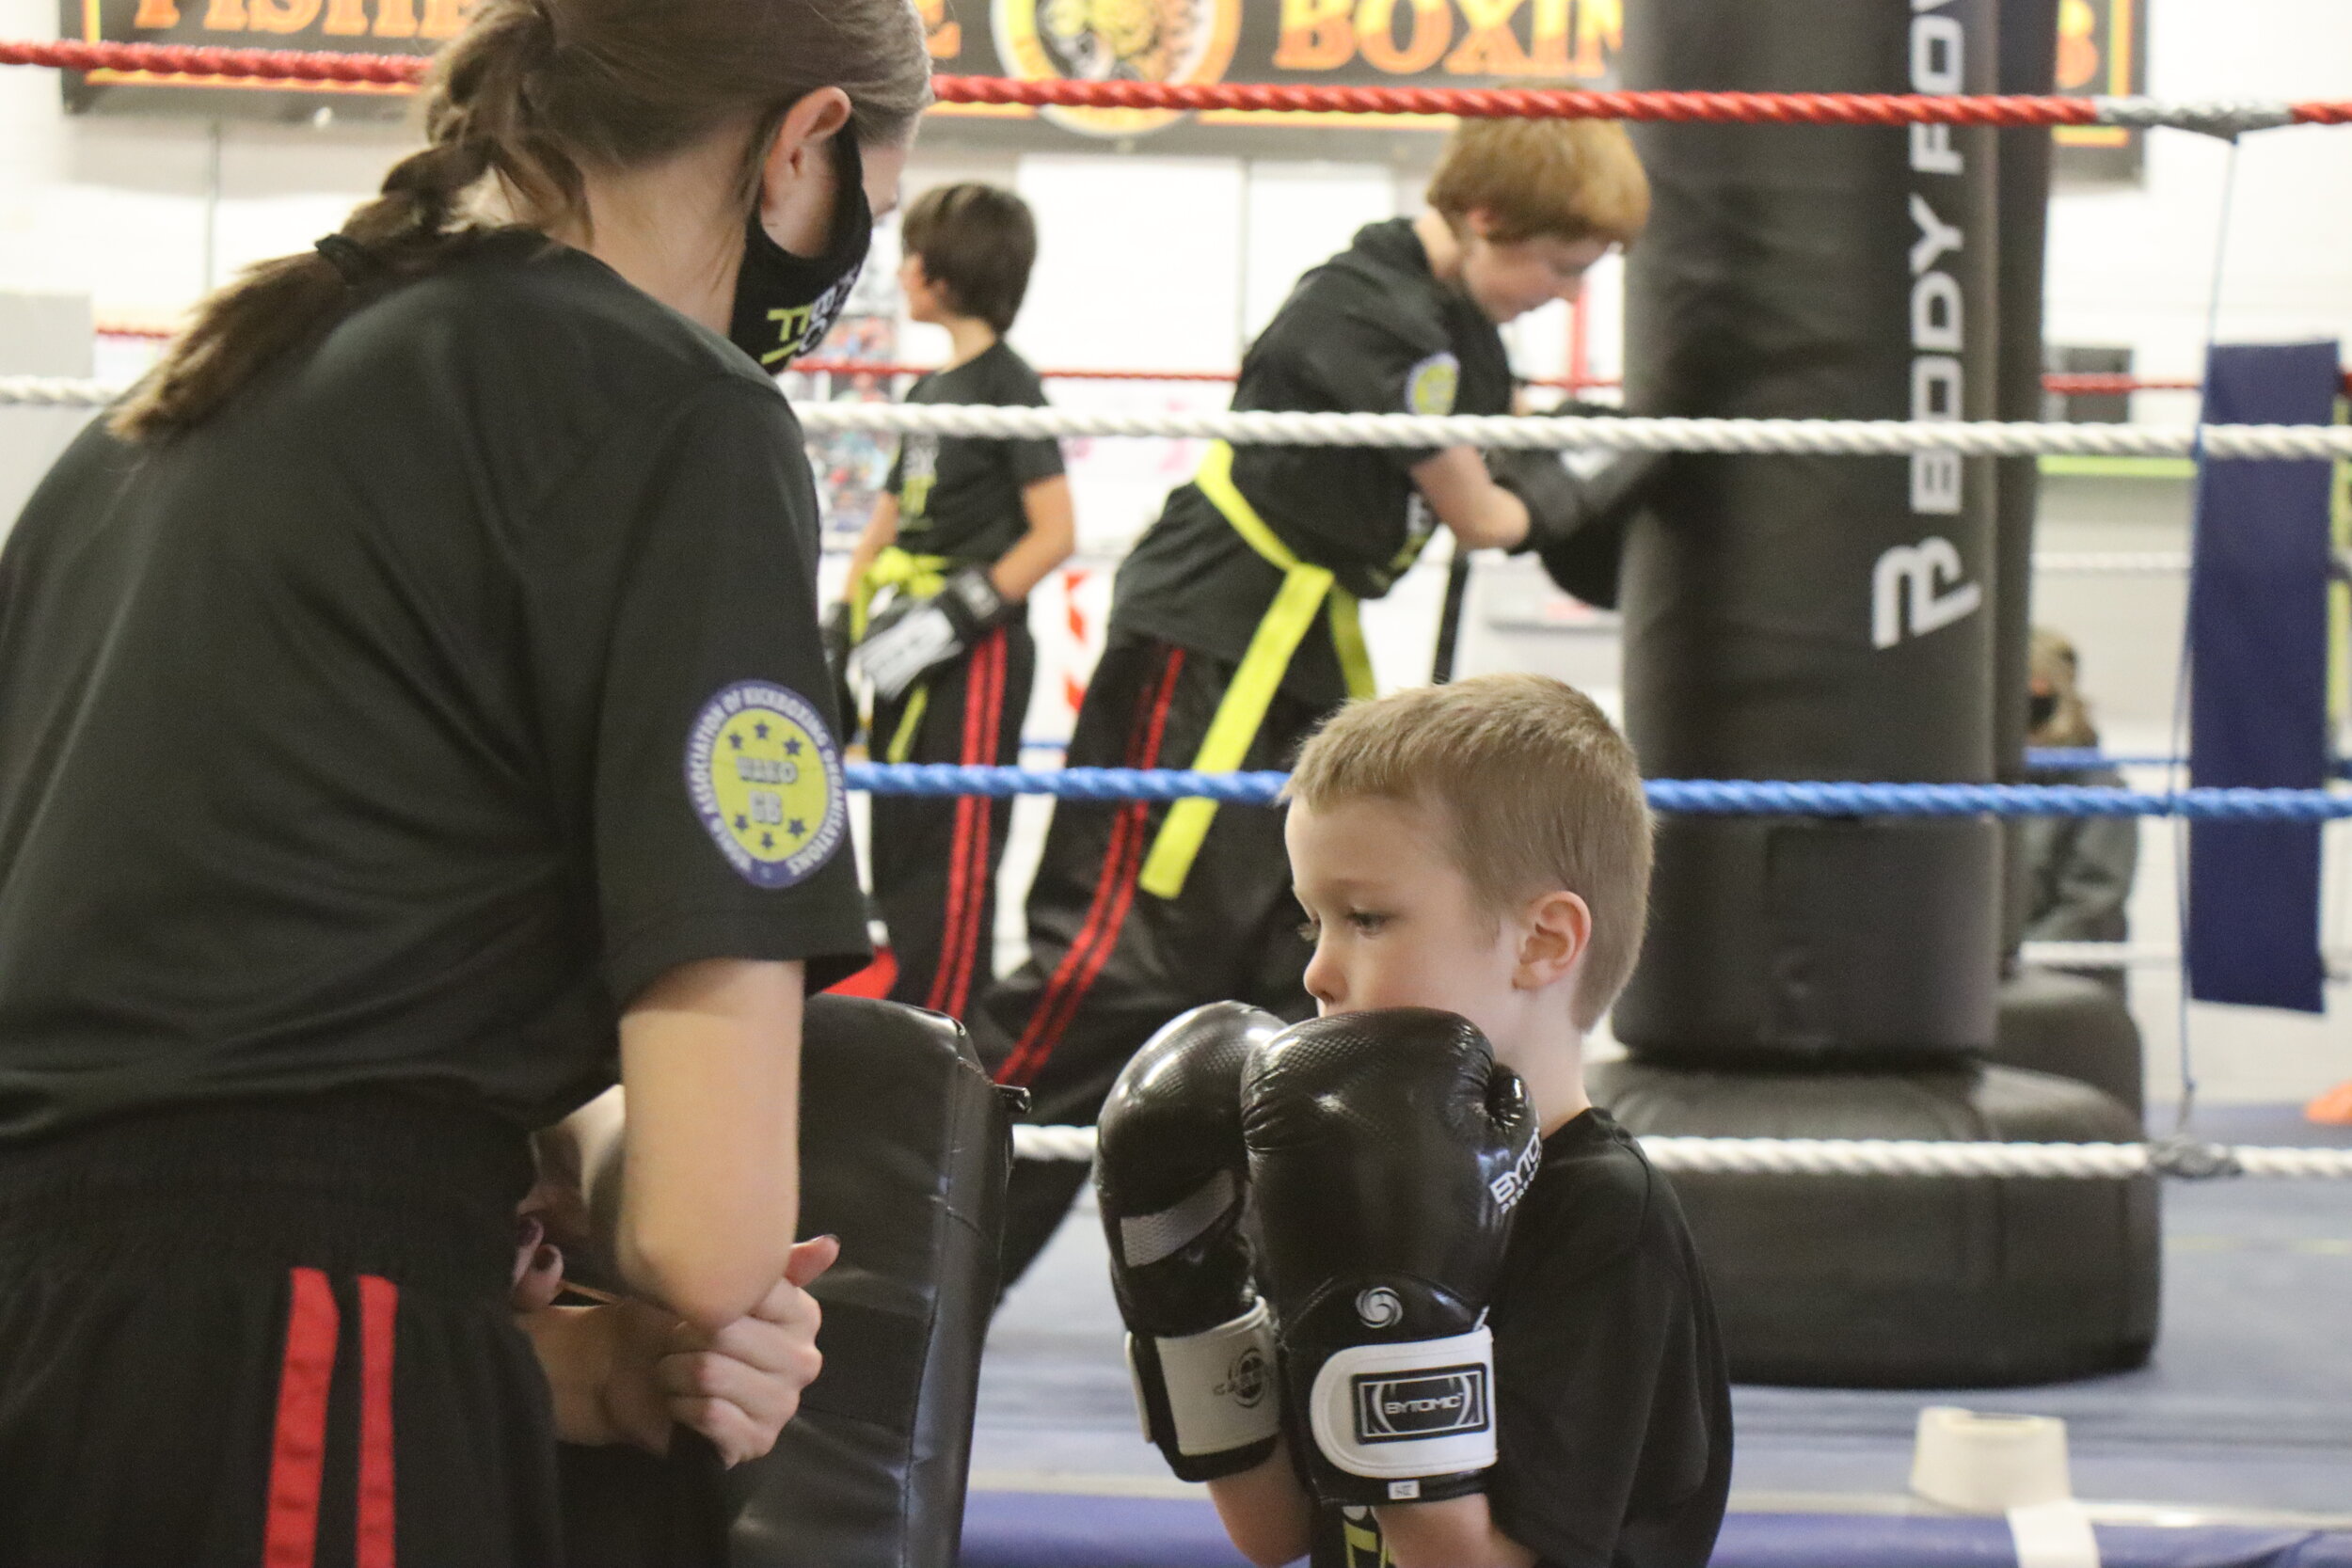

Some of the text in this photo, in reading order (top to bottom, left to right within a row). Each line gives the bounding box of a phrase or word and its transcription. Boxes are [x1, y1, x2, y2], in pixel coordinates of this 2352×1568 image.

[1910, 194, 1964, 515] BODY
[689, 704, 727, 816] ASSOCIATION
[720, 689, 742, 712] OF
